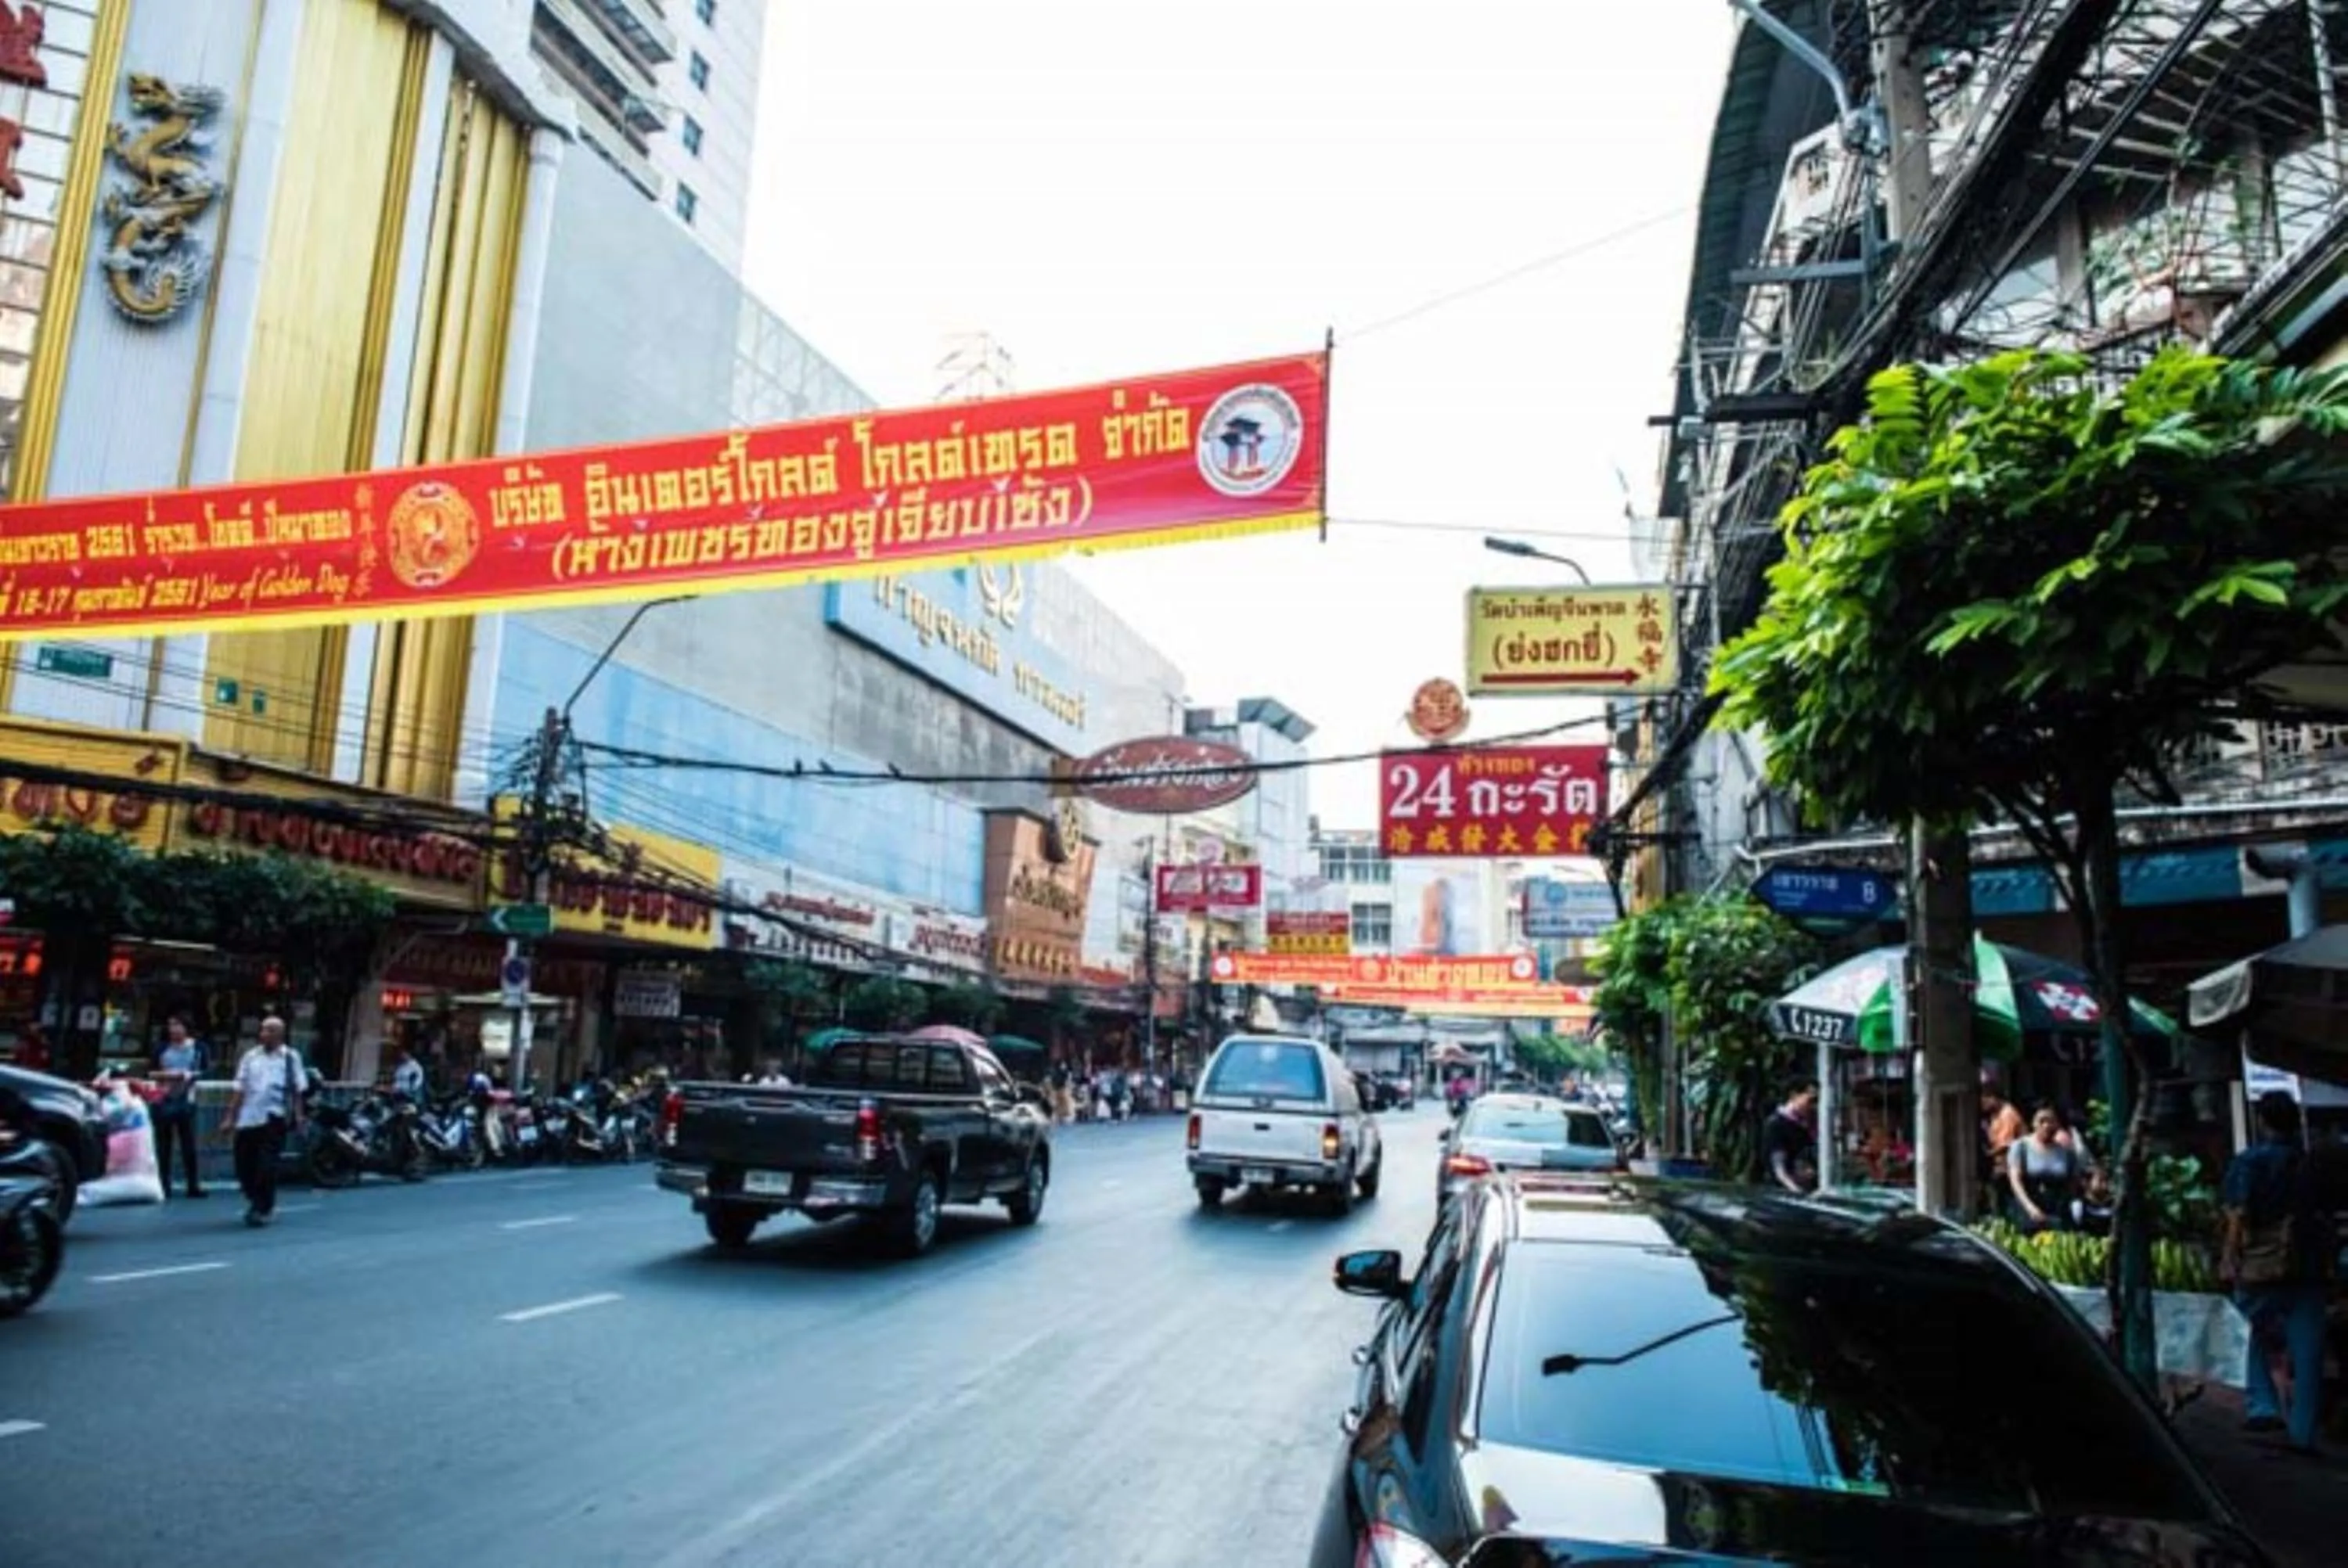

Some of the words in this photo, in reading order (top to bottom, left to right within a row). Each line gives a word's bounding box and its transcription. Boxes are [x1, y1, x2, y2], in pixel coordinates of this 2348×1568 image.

[489, 462, 566, 528] บริษัท
[1103, 389, 1190, 460] จำกัด
[238, 566, 261, 612] of
[315, 562, 351, 605] Dog
[1388, 764, 1457, 818] 24
[1466, 762, 1599, 817] กะรัต
